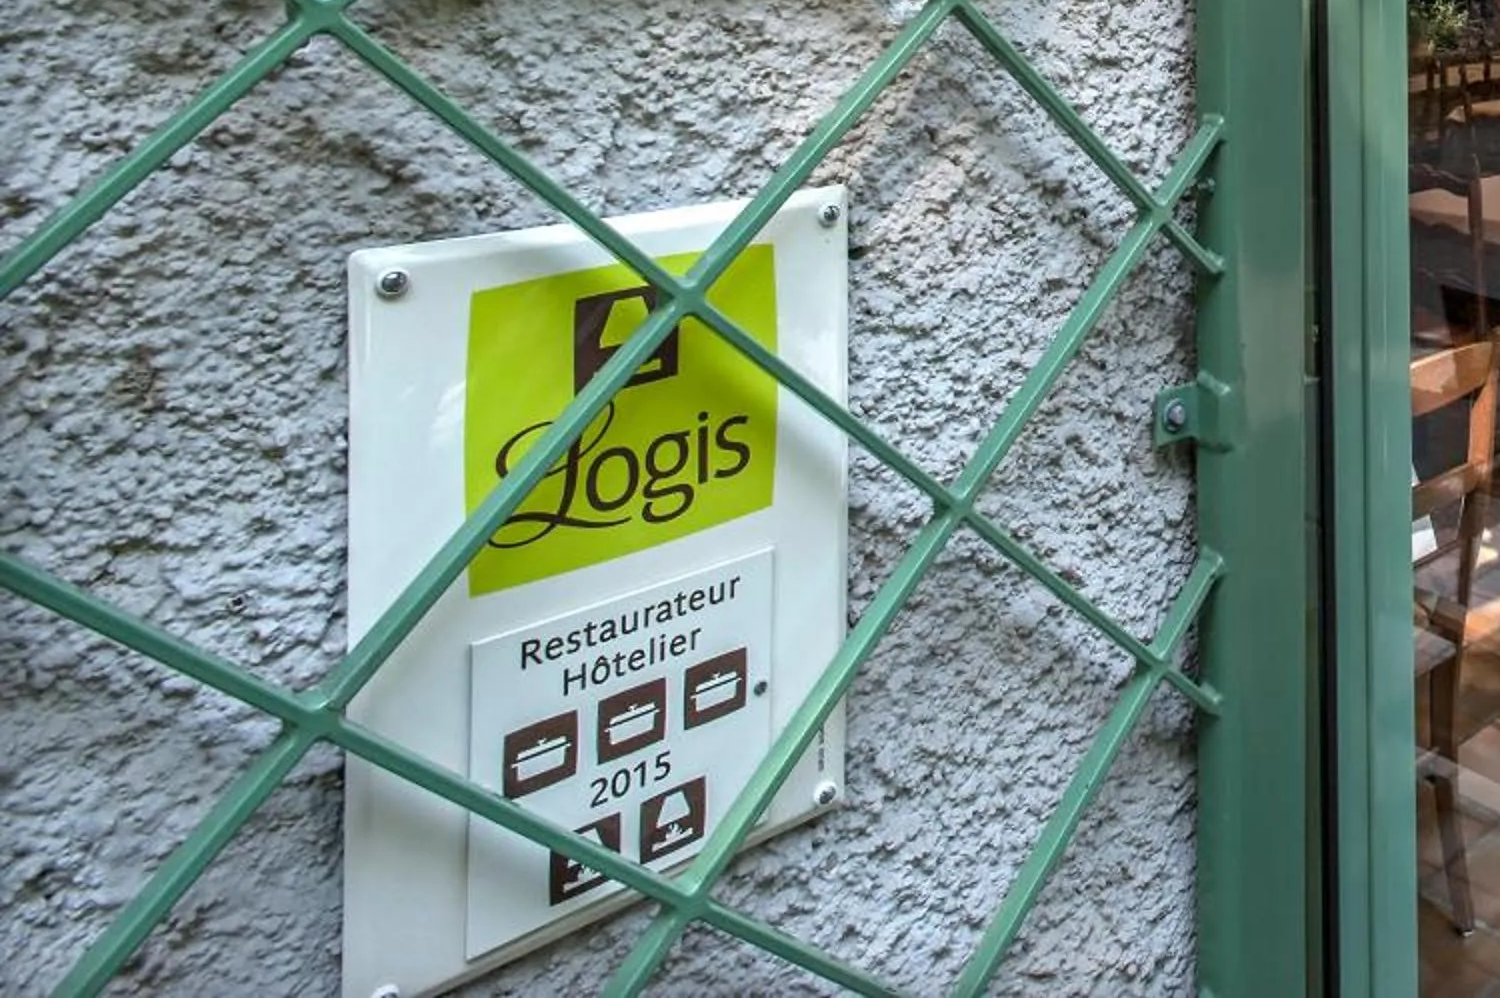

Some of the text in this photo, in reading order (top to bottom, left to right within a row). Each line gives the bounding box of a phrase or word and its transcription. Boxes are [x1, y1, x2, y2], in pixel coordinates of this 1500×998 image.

[487, 398, 752, 549] Logis
[520, 576, 742, 670] Restaurateur
[563, 627, 702, 696] Hôtelier
[590, 751, 672, 808] 2015
